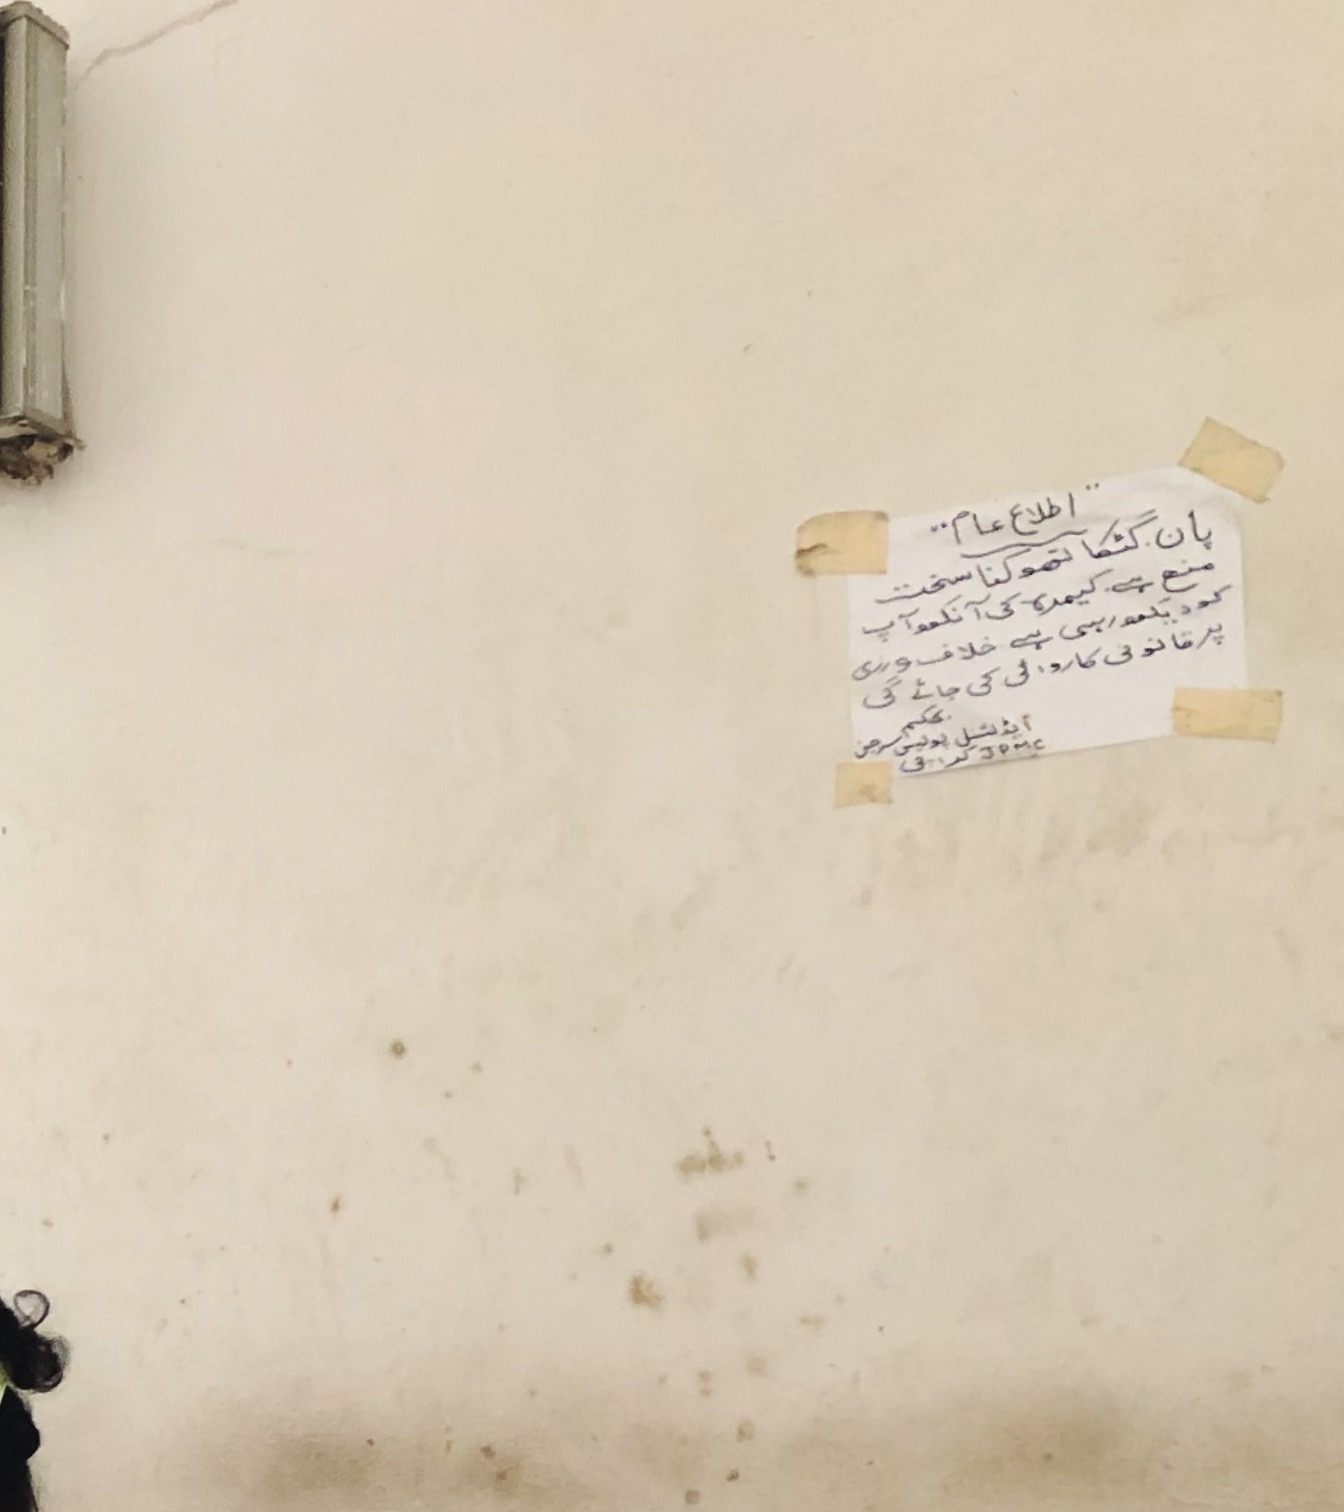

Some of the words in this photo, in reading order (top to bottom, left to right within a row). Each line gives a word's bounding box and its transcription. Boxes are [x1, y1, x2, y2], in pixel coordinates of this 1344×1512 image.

[874, 570, 973, 605] سخت
[1162, 559, 1215, 593] منع
[985, 592, 1023, 621] کی
[1197, 584, 1233, 610] کو
[862, 607, 921, 644] آپ
[1010, 629, 1053, 650] ہے
[1197, 623, 1225, 650] پر
[917, 636, 998, 666] خلاف
[851, 656, 912, 681] ورزی
[967, 667, 1002, 698] کی
[862, 676, 904, 709] گی
